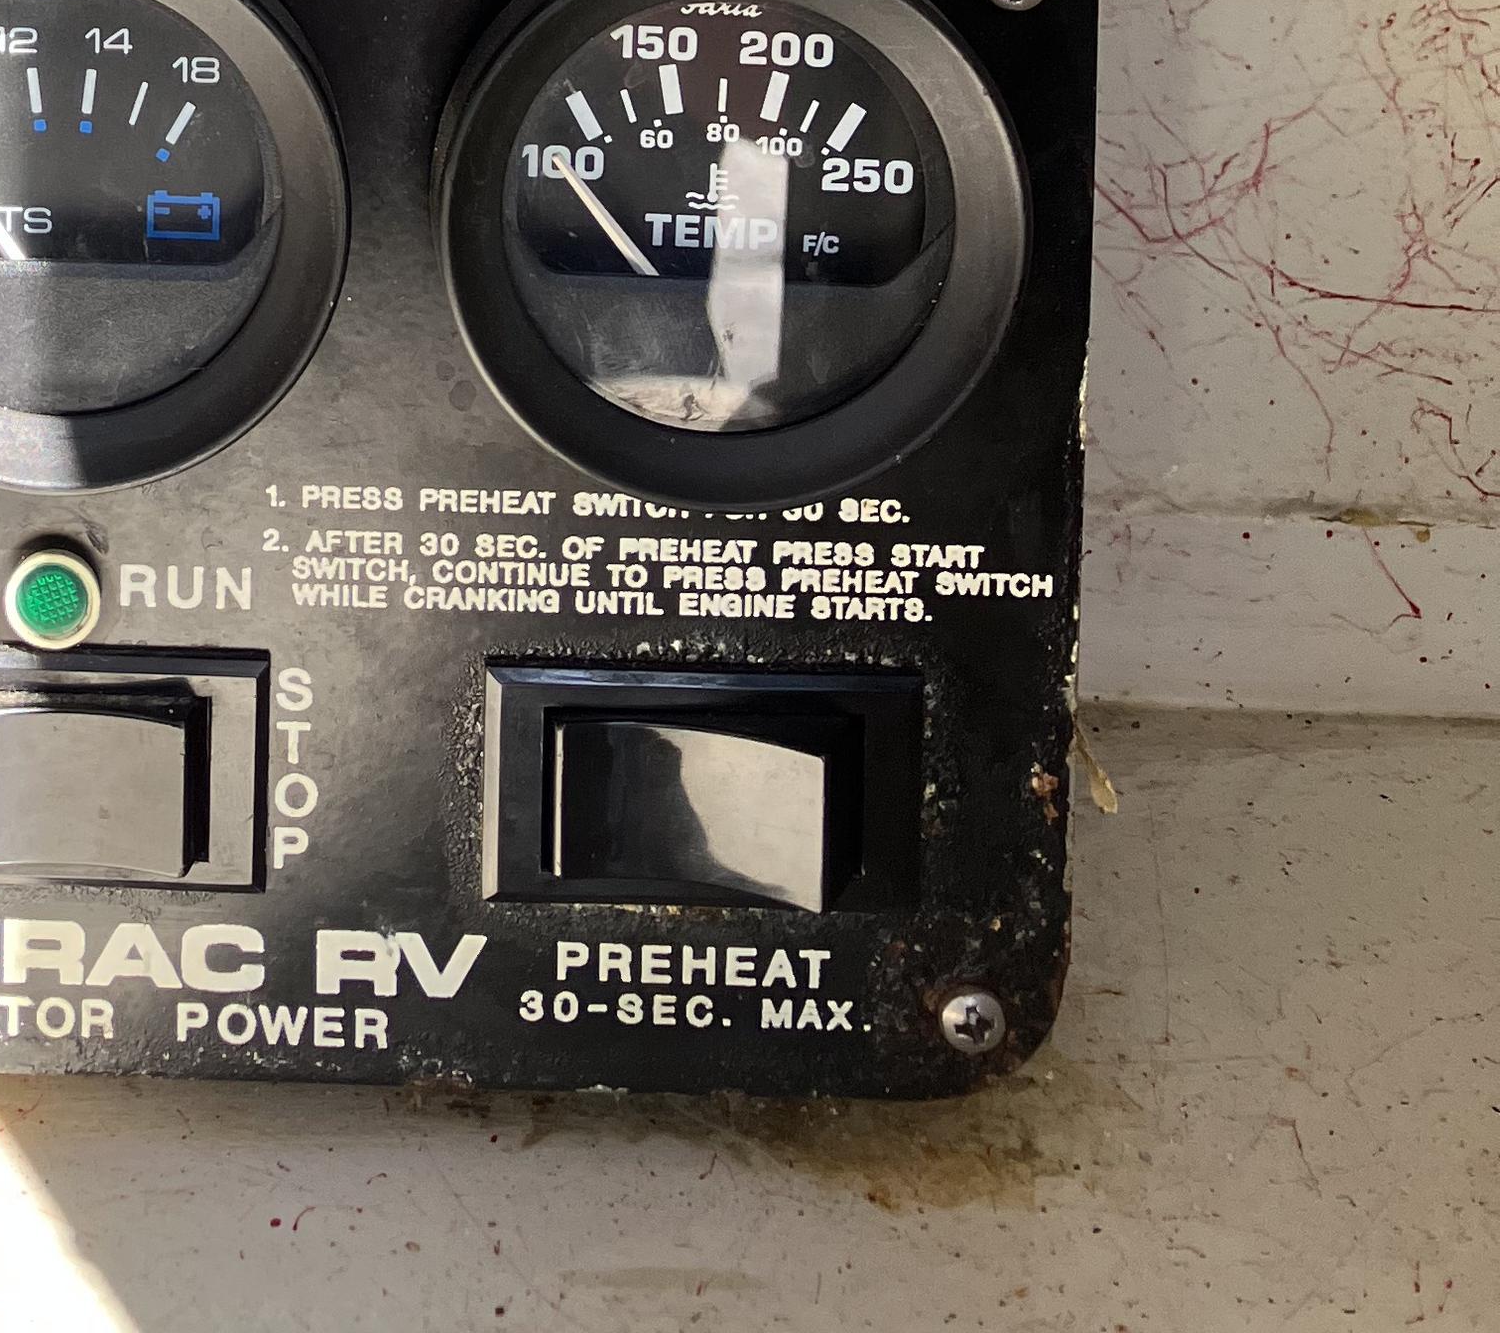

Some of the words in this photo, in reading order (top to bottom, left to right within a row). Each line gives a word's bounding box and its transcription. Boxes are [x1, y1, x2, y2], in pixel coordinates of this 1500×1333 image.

[85, 28, 133, 55] 14
[610, 25, 698, 62] 150
[739, 31, 834, 68] 200
[172, 57, 220, 84] 18
[640, 129, 674, 149] 60
[706, 123, 739, 143] 80
[756, 136, 803, 157] 100
[521, 145, 605, 181] 100
[821, 158, 914, 194] 250
[645, 213, 778, 249] TEMP
[802, 233, 840, 255] F/C
[266, 485, 286, 508] 1.
[302, 485, 403, 511] PRESS
[420, 489, 556, 515] PREHEAT
[838, 498, 910, 523] SEC.
[262, 529, 289, 552] 2.
[305, 531, 403, 555] AFTER
[420, 533, 459, 557] 30
[475, 534, 546, 559] SEC.
[562, 536, 604, 560] OF
[619, 538, 758, 564] PREHEAT
[773, 541, 874, 567] PRESS
[891, 544, 984, 569] START
[119, 564, 252, 611] RUN
[292, 557, 416, 586] SWITCH,
[432, 560, 590, 588] CONTINUE
[607, 563, 648, 588] TO
[663, 566, 766, 592] PRESS
[781, 568, 919, 594] PREHEAT
[936, 572, 1053, 598] SWITCH
[292, 583, 388, 609] WHILE
[404, 586, 560, 614] CRANKING
[575, 590, 664, 616] UNTIL
[679, 593, 795, 619] ENGINE
[811, 596, 932, 622] STARTS.
[273, 667, 319, 870] STOP
[317, 928, 488, 999] RV
[557, 940, 831, 989] PREHEAT
[177, 1002, 390, 1050] POWER
[519, 990, 732, 1027] 30-SEC.
[761, 999, 872, 1032] MAX.
